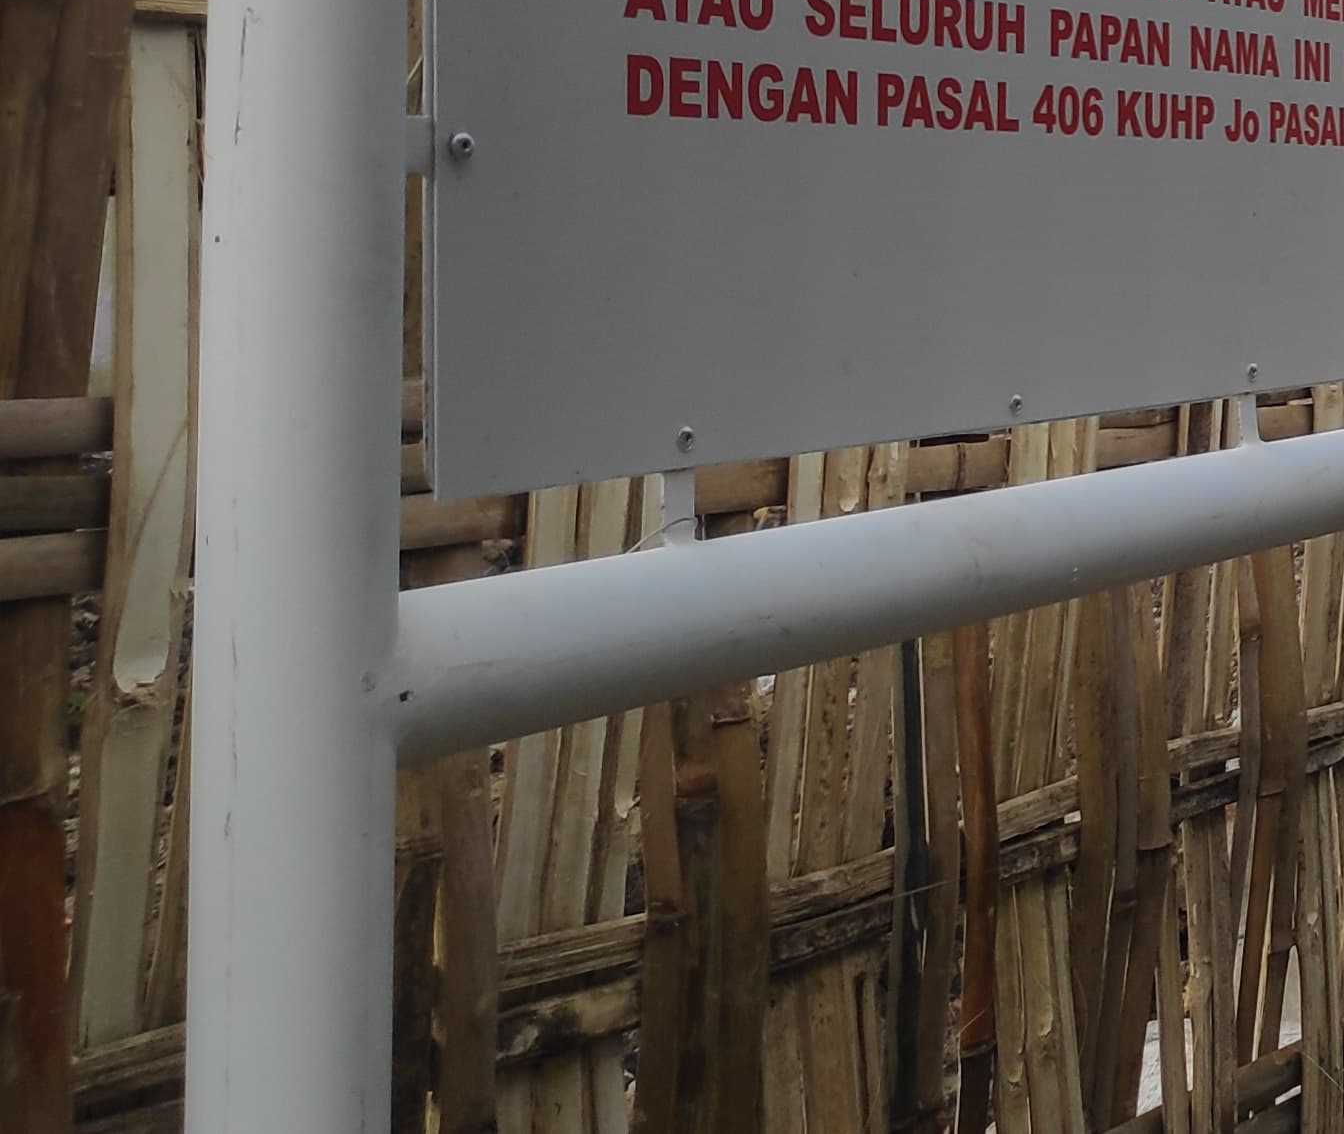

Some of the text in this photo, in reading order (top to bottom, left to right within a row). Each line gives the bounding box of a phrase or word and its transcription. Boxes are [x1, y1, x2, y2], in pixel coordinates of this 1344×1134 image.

[1050, 8, 1170, 67] PAPAN
[1190, 25, 1280, 78] NAMA
[1294, 38, 1330, 83] INI
[626, 53, 859, 126] DENGAN
[877, 72, 1020, 133] PASAL
[1032, 84, 1104, 137] 406
[1116, 89, 1215, 141] KUHP
[1224, 98, 1260, 143] Jo
